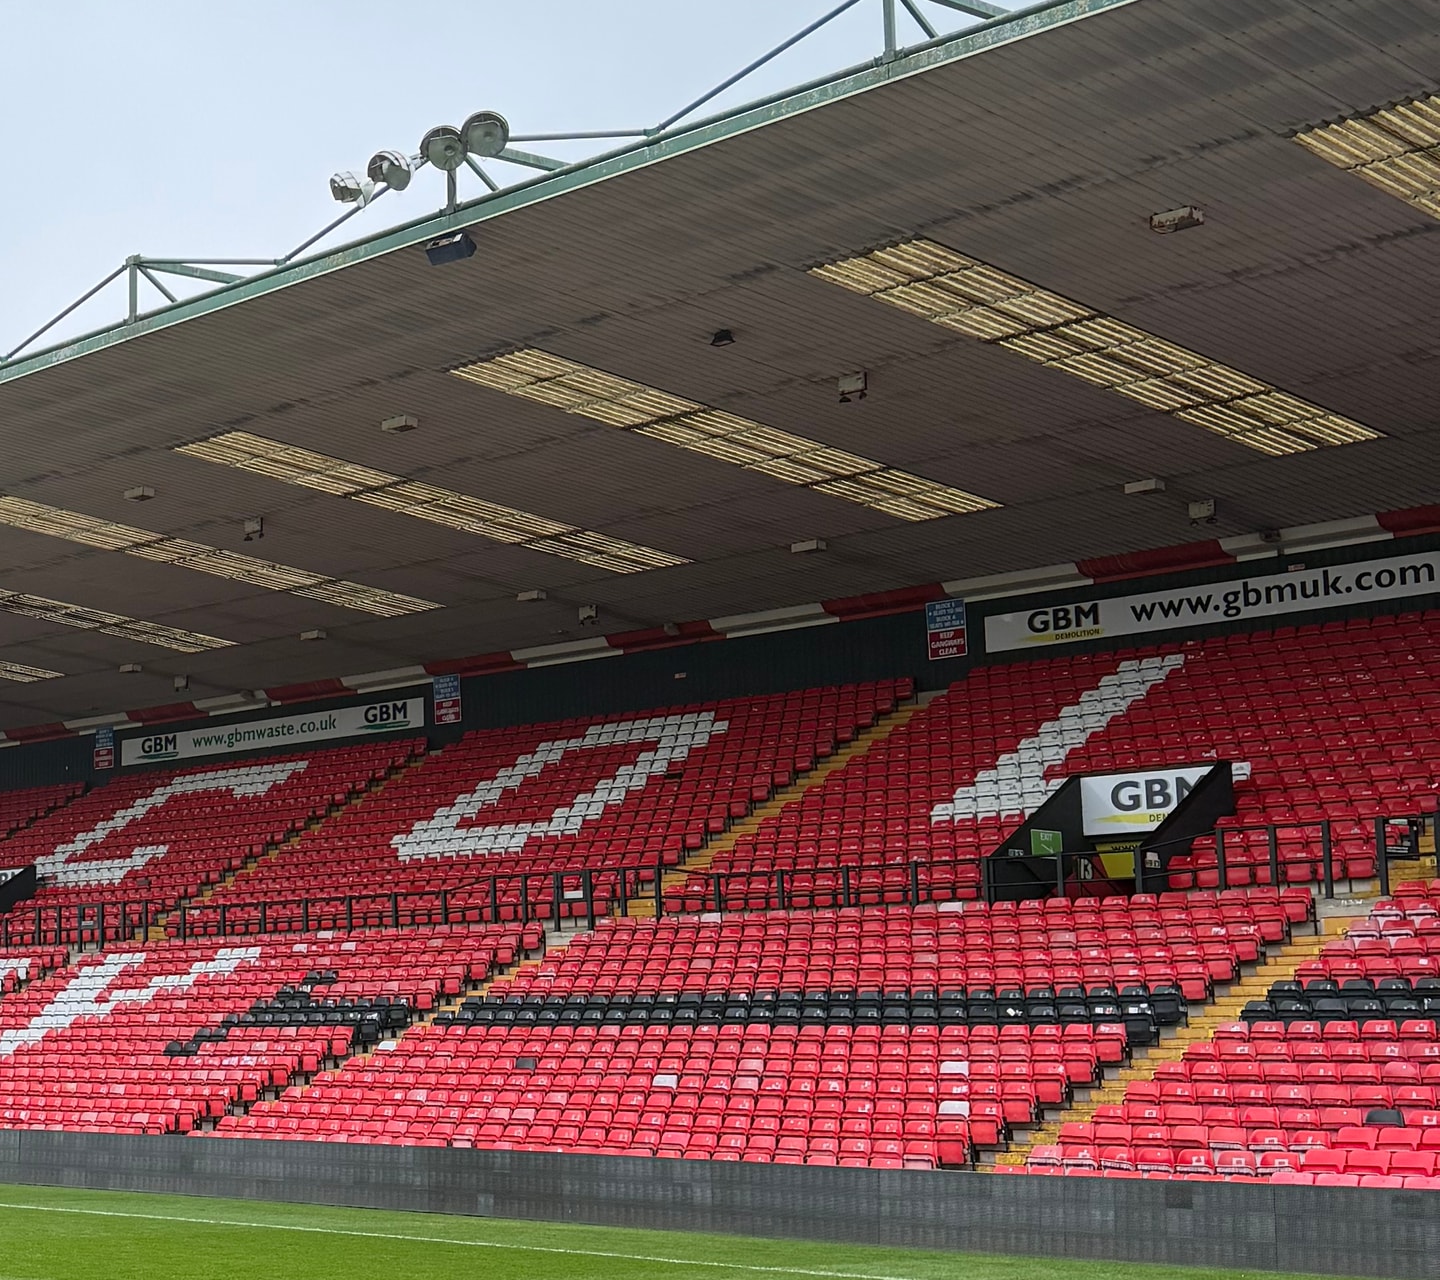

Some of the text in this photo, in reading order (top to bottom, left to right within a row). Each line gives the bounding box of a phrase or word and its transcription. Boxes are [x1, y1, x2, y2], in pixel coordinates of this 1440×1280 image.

[1027, 561, 1435, 633] GBM www.gbmuk.com
[1055, 628, 1100, 641] DEMOLITION
[141, 734, 178, 755] GBM
[192, 715, 336, 749] www.gbmwaste.co.uk
[363, 701, 408, 725] GBM
[1039, 832, 1053, 842] EXIT
